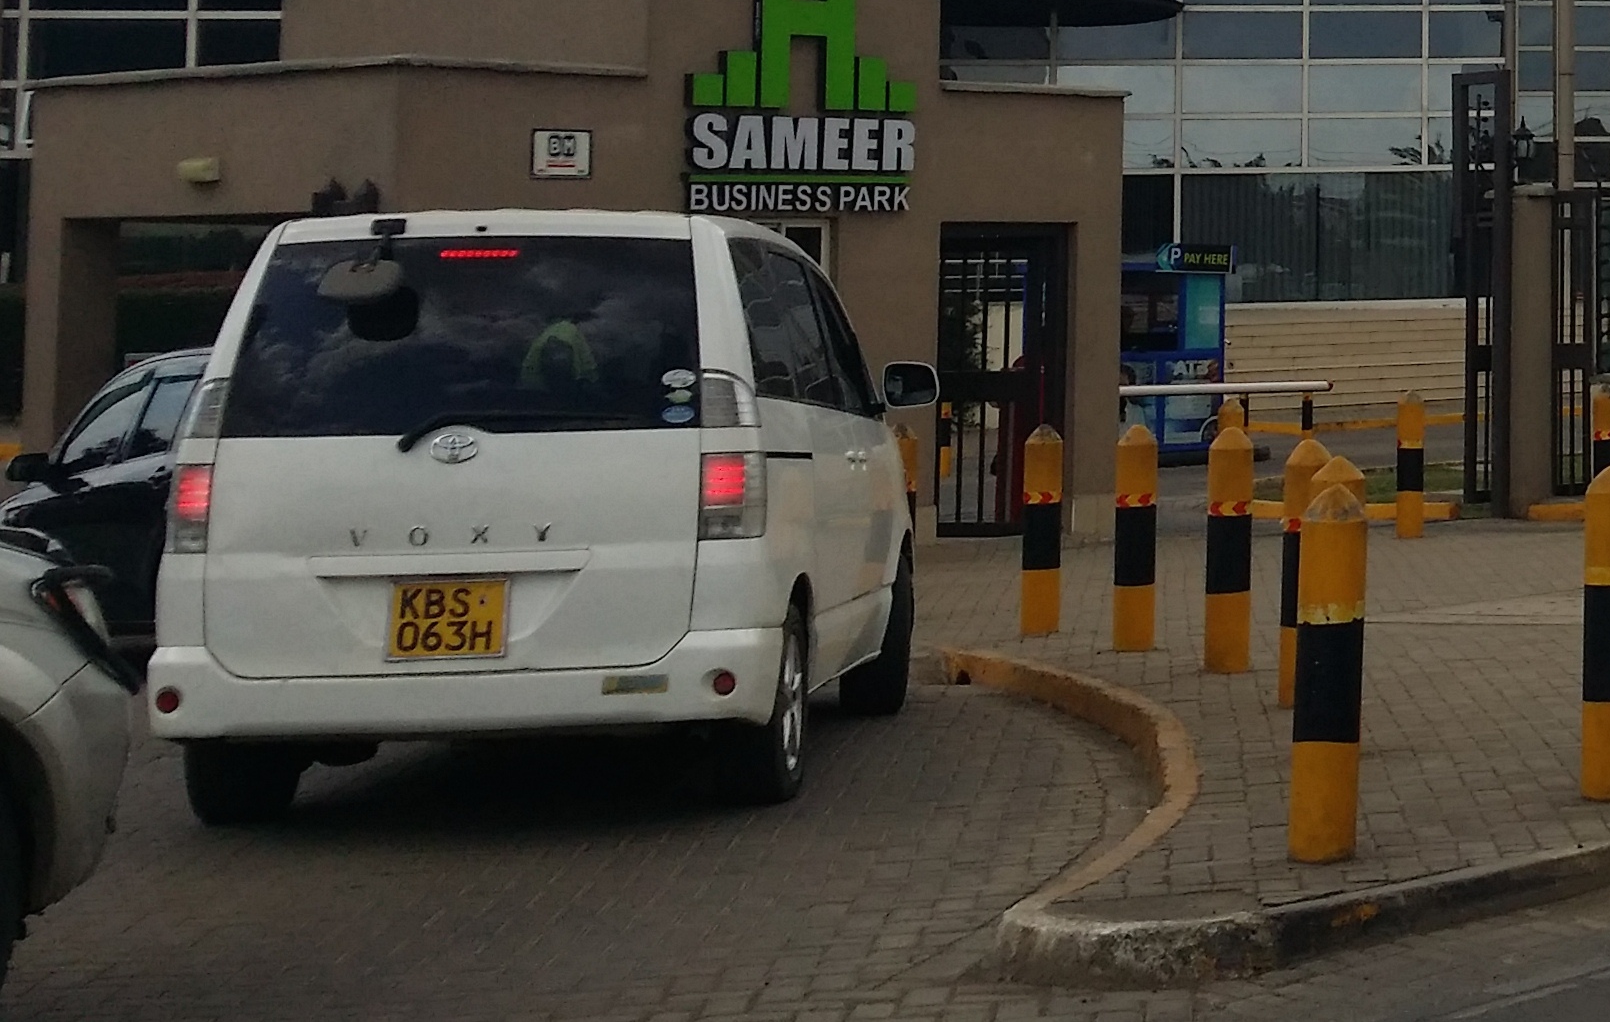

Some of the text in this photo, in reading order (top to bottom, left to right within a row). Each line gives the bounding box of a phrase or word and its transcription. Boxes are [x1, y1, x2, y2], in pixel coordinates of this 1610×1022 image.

[692, 113, 915, 171] SAMEER
[690, 184, 911, 212] BUSINESS PARK
[1170, 247, 1229, 265] P PAY HERE
[349, 522, 552, 547] VOXY
[399, 587, 470, 619] KBS
[396, 620, 493, 654] 063H
